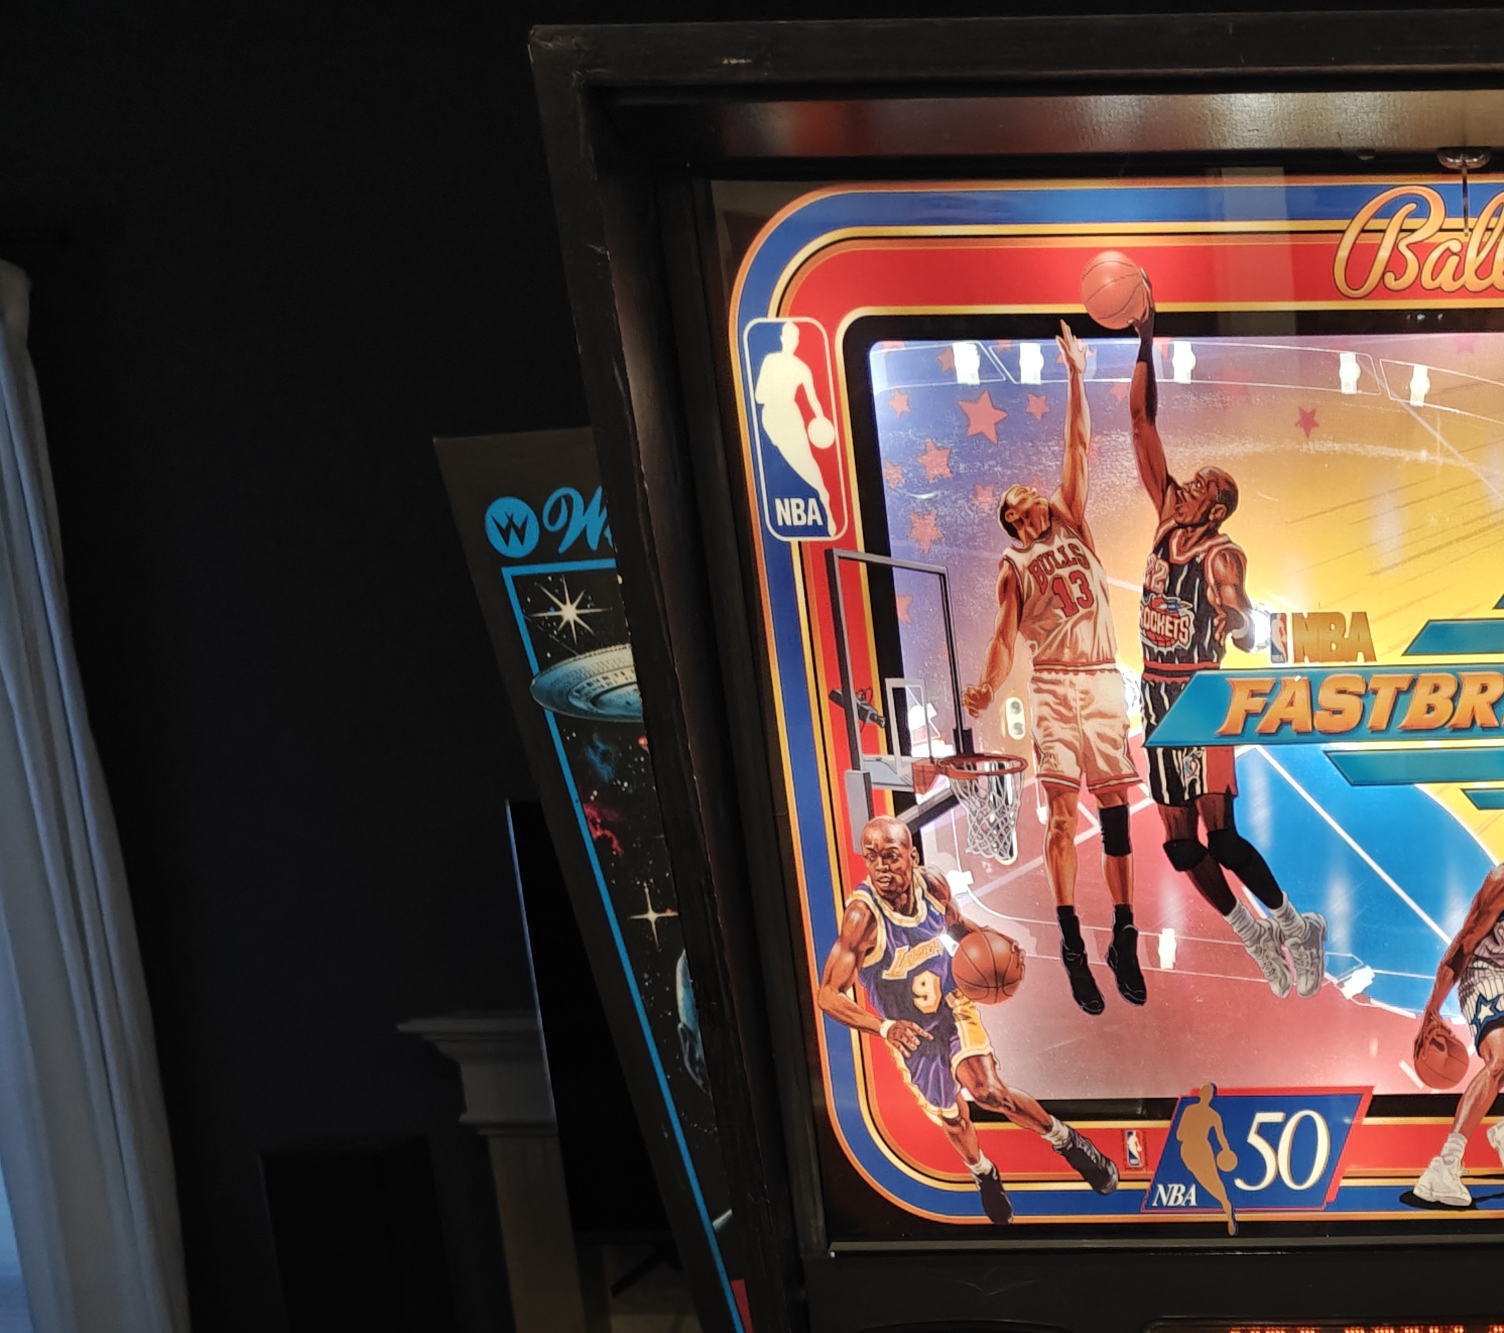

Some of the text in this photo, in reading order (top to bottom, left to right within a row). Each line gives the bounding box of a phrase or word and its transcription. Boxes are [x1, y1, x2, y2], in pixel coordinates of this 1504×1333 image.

[775, 497, 822, 528] NBA
[1028, 543, 1088, 586] BULLS
[1051, 571, 1094, 617] 13
[1291, 611, 1377, 663] NBA
[911, 974, 942, 1014] 9
[1152, 1109, 1332, 1208] NBA 50
